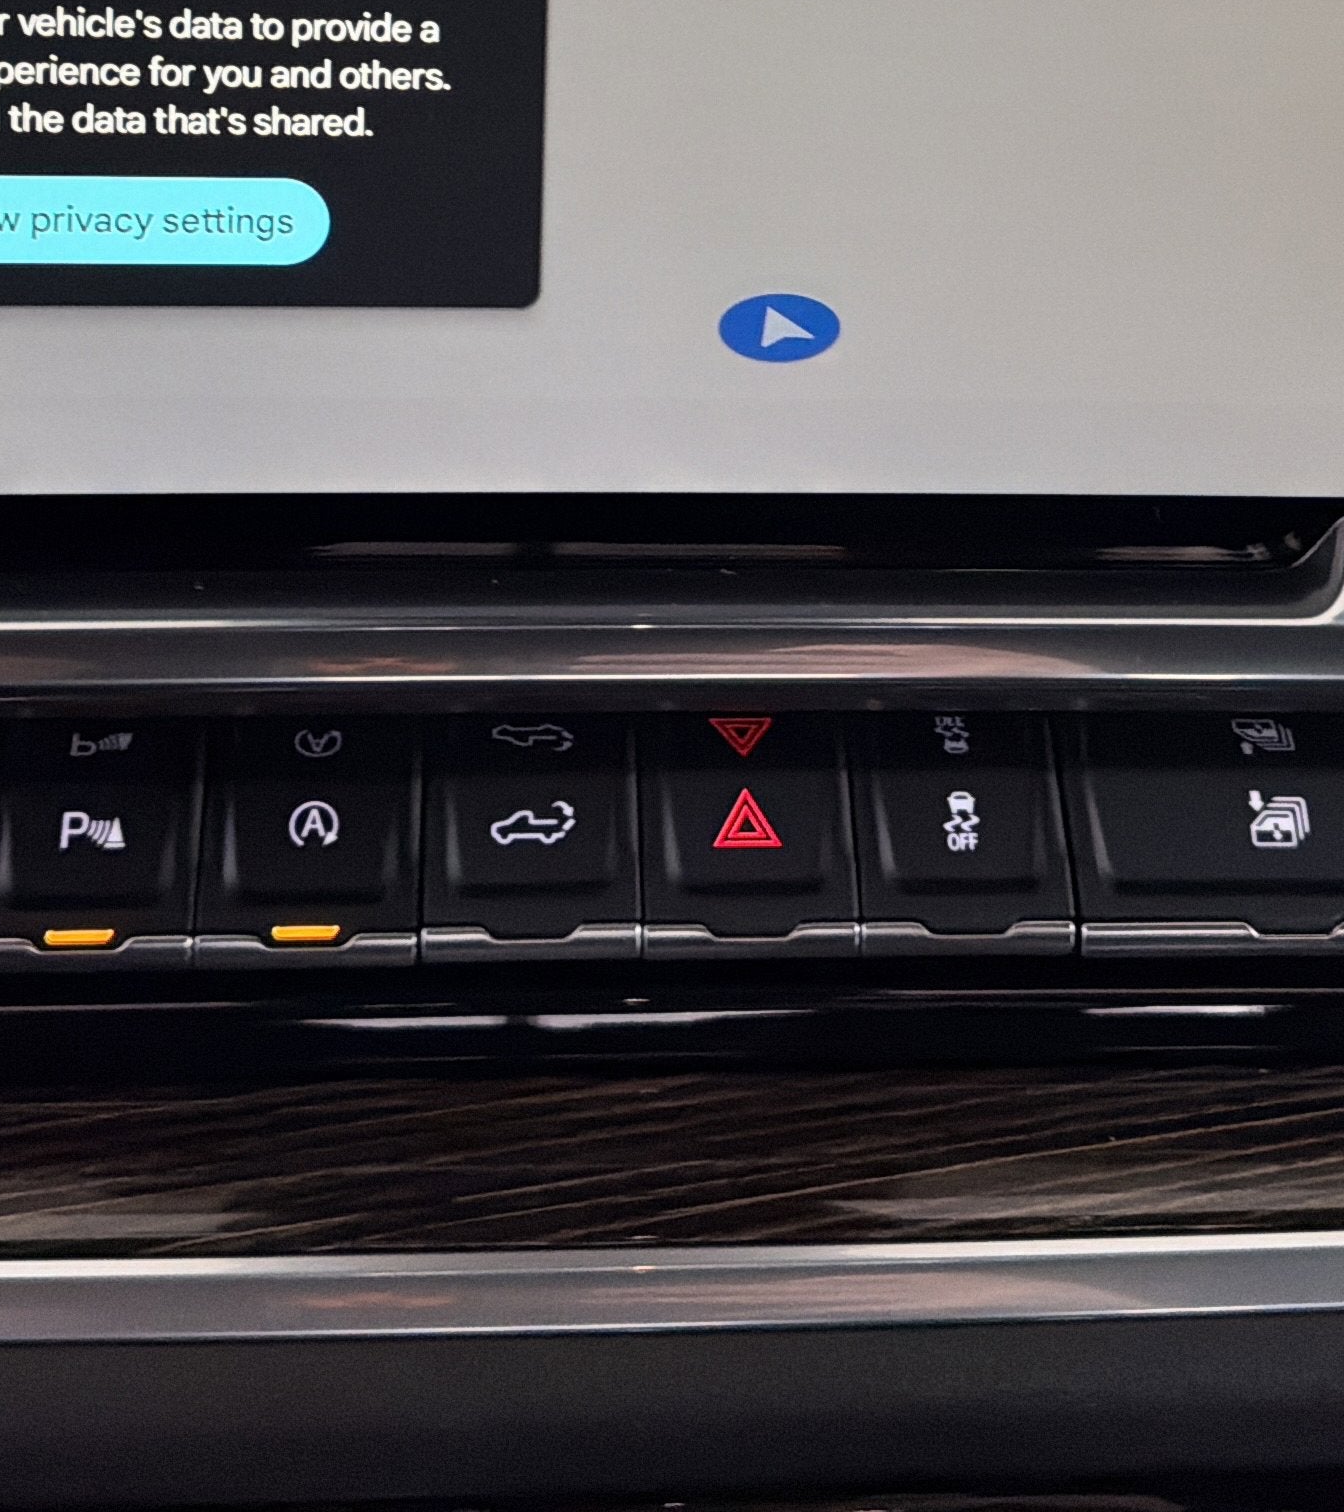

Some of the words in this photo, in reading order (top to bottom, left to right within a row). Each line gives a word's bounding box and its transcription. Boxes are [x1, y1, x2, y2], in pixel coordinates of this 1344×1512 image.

[17, 6, 162, 38] vehicle's
[169, 8, 242, 39] data
[250, 13, 284, 40] to
[292, 12, 412, 48] provide
[420, 21, 440, 43] a
[148, 55, 196, 86] for
[203, 65, 262, 94] you
[271, 59, 332, 89] and
[339, 60, 451, 90] others.
[8, 102, 64, 133] the
[72, 103, 146, 134] data
[153, 104, 246, 135] that's
[253, 106, 373, 136] shared.
[32, 205, 153, 240] privacy
[163, 206, 292, 241] settings
[947, 832, 979, 851] OFF
